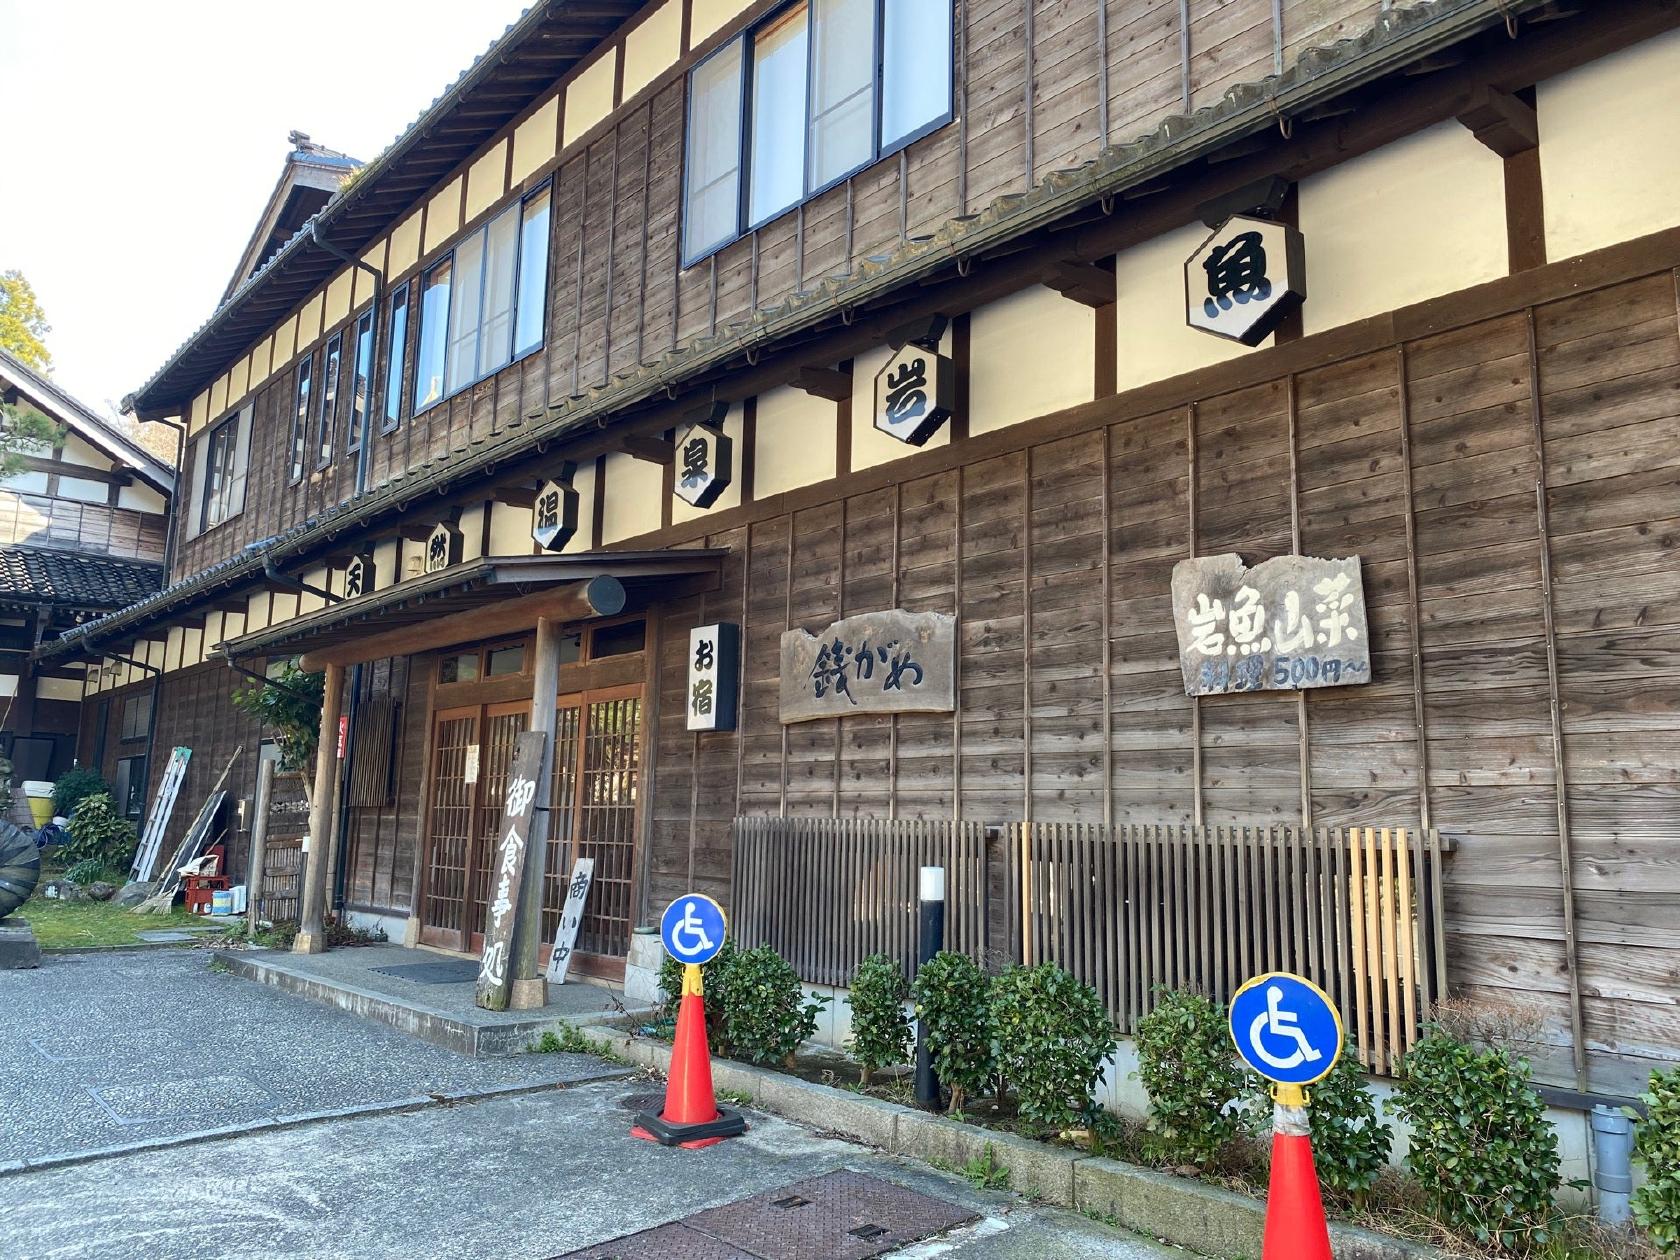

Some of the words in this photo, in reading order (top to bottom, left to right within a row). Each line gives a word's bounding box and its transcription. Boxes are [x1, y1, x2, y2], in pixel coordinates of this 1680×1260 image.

[1203, 231, 1271, 318] 魚
[886, 357, 927, 425] 岩
[681, 438, 709, 488] 泉
[539, 491, 558, 529] 温
[347, 562, 362, 598] 天
[430, 533, 447, 570] 然
[1186, 572, 1359, 656] 岩魚山菜
[692, 639, 714, 717] お宿
[479, 778, 535, 988] 御食事処
[552, 871, 589, 972] 商い中
